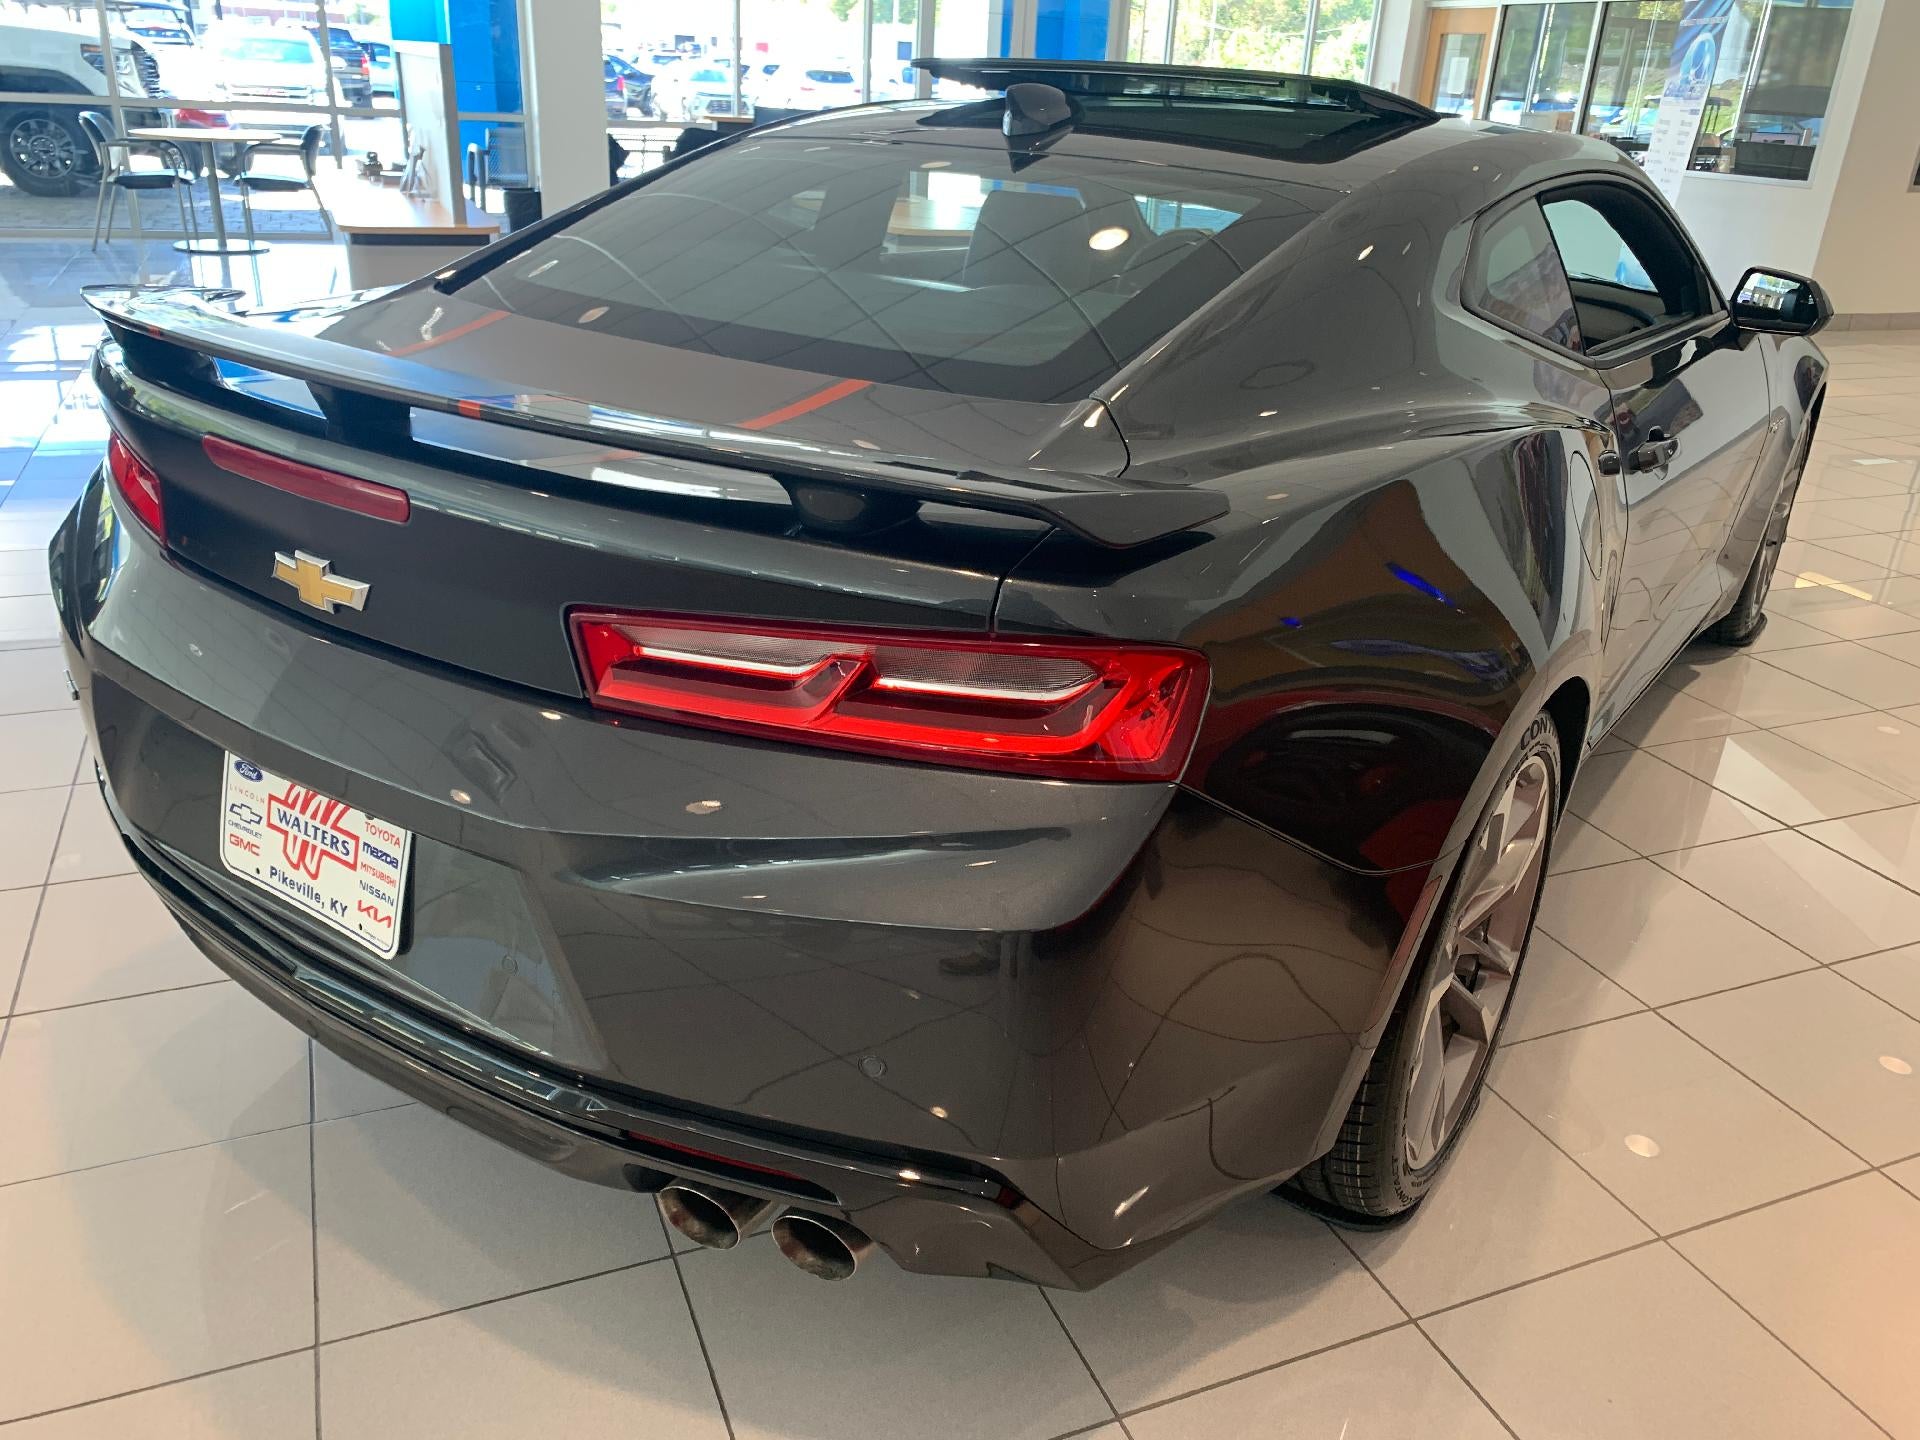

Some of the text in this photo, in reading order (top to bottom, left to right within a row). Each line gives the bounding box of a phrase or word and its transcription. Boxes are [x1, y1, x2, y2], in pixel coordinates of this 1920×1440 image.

[236, 760, 260, 780] Ford
[229, 784, 265, 804] LINCOLN
[228, 819, 262, 839] CHEVROLET
[277, 808, 350, 857] WALTERS
[365, 821, 401, 849] TOYOTA
[229, 834, 261, 856] GMC
[360, 861, 397, 888] MITSUBISHI
[269, 866, 348, 918] Pikeville, KY
[359, 880, 395, 907] NISSAN
